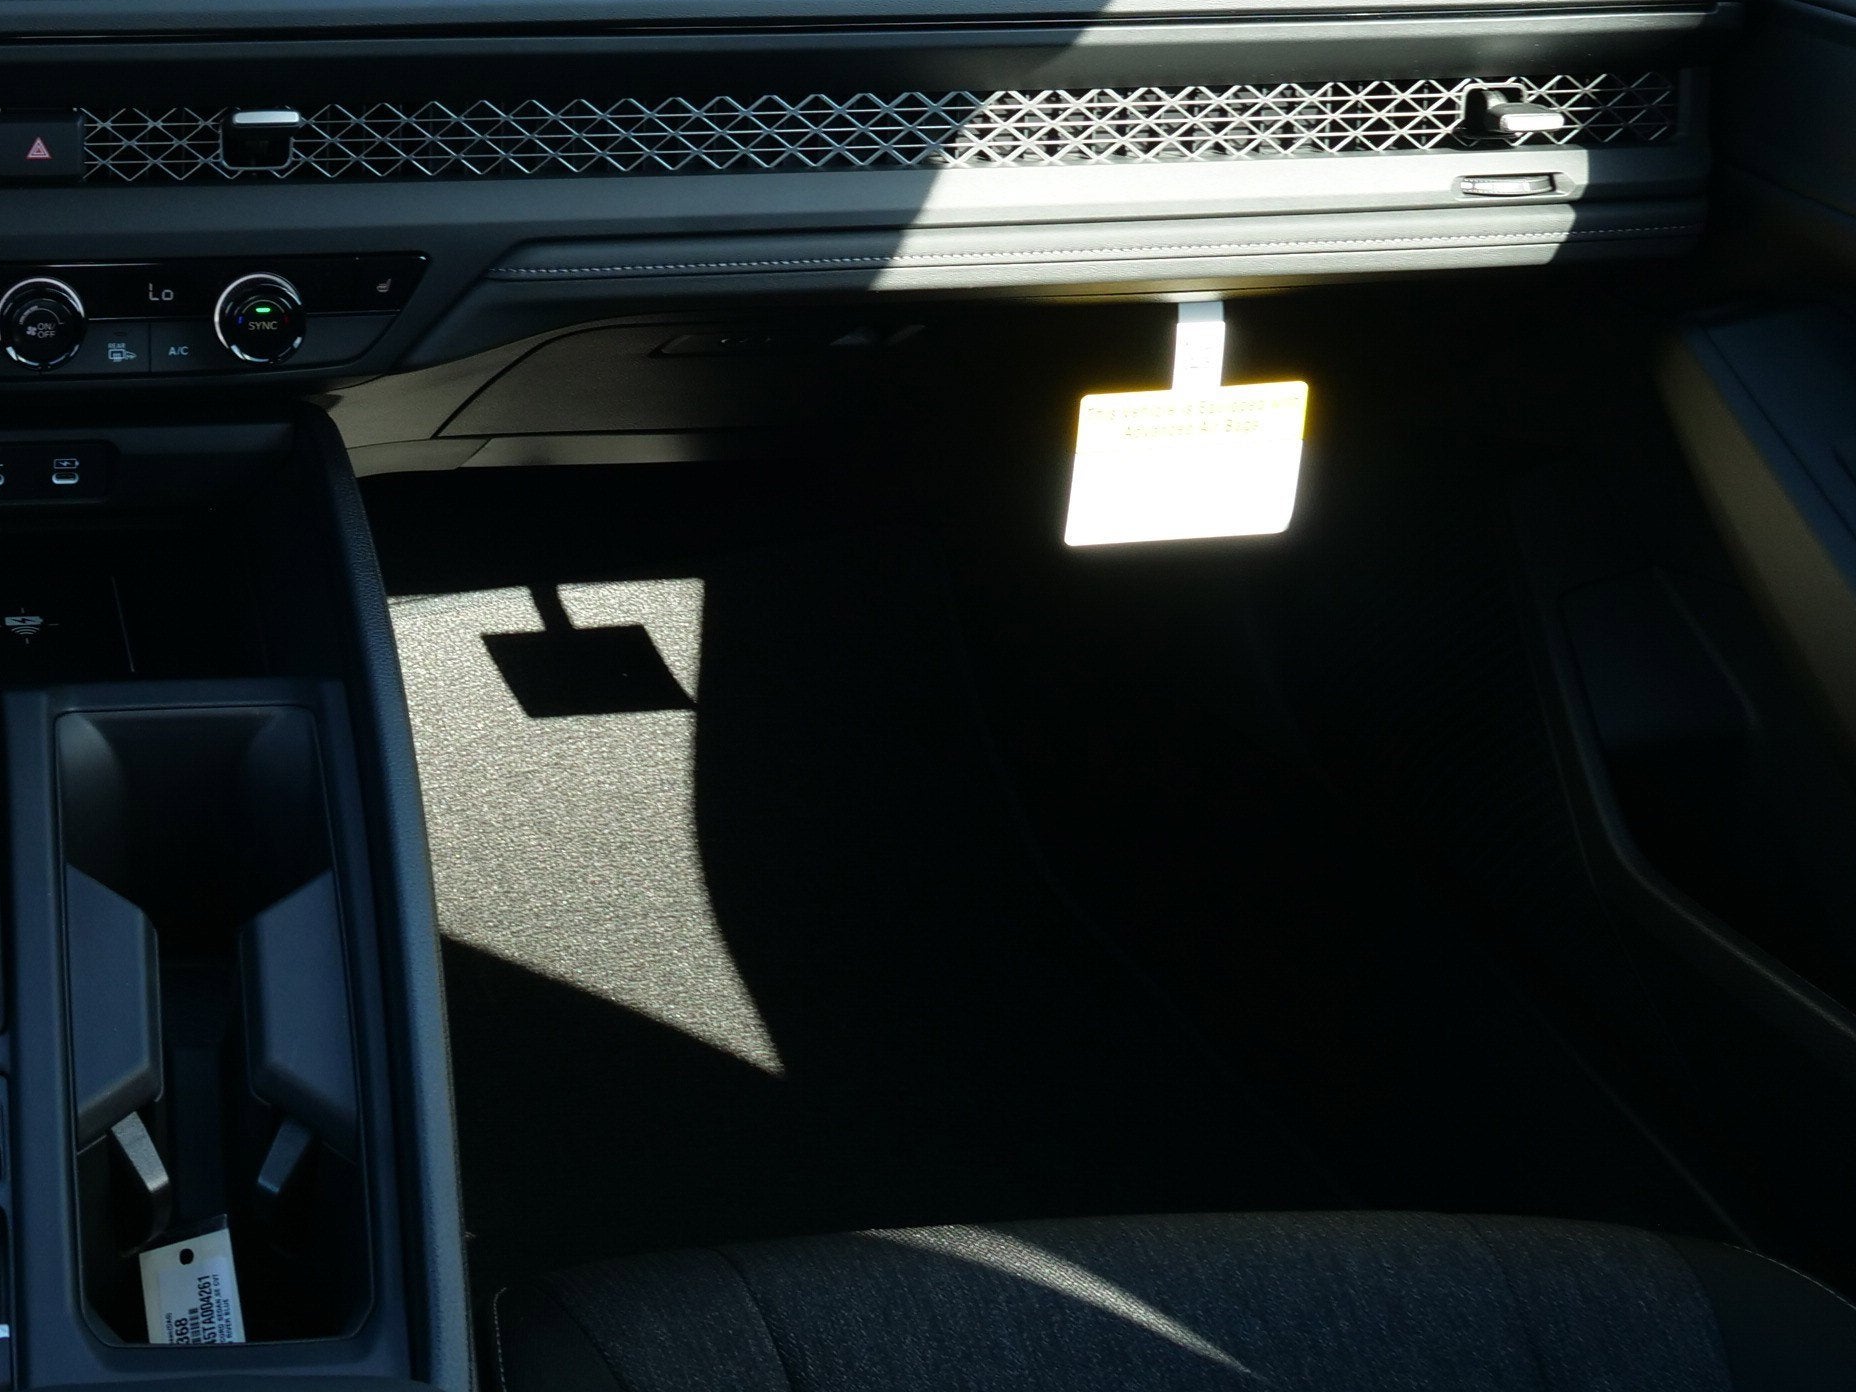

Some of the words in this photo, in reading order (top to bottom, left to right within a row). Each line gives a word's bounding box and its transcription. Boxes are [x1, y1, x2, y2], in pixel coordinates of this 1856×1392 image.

[37, 323, 55, 331] ON/
[248, 321, 279, 331] SYNC
[37, 330, 55, 339] OFF
[168, 346, 189, 357] A/C
